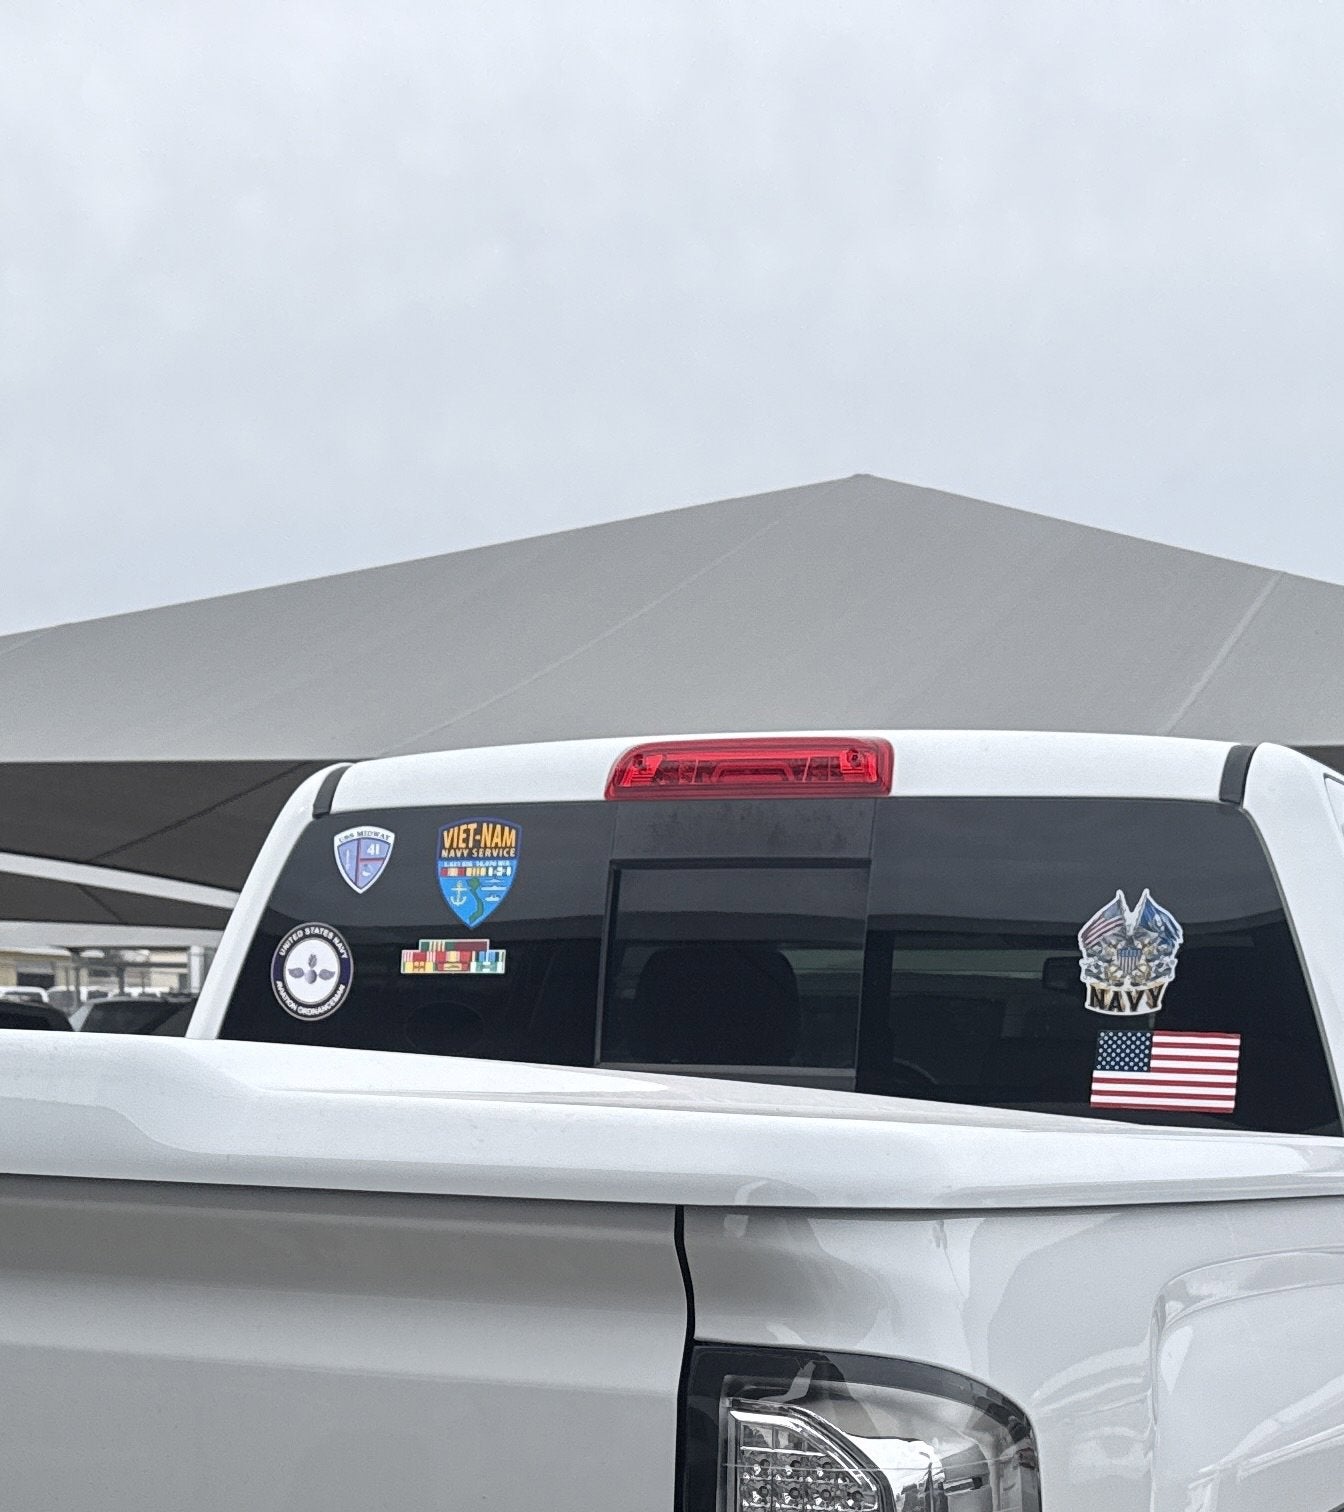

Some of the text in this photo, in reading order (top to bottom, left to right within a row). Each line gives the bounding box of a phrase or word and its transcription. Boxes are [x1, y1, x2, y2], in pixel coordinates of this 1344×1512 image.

[357, 830, 391, 840] MIDWAY
[443, 822, 516, 849] VIET-NAM
[367, 843, 380, 856] 41
[441, 848, 516, 858] NAVY SERVICE
[278, 926, 349, 959] UNITED STATES NAVY
[1090, 983, 1165, 1012] NAVY
